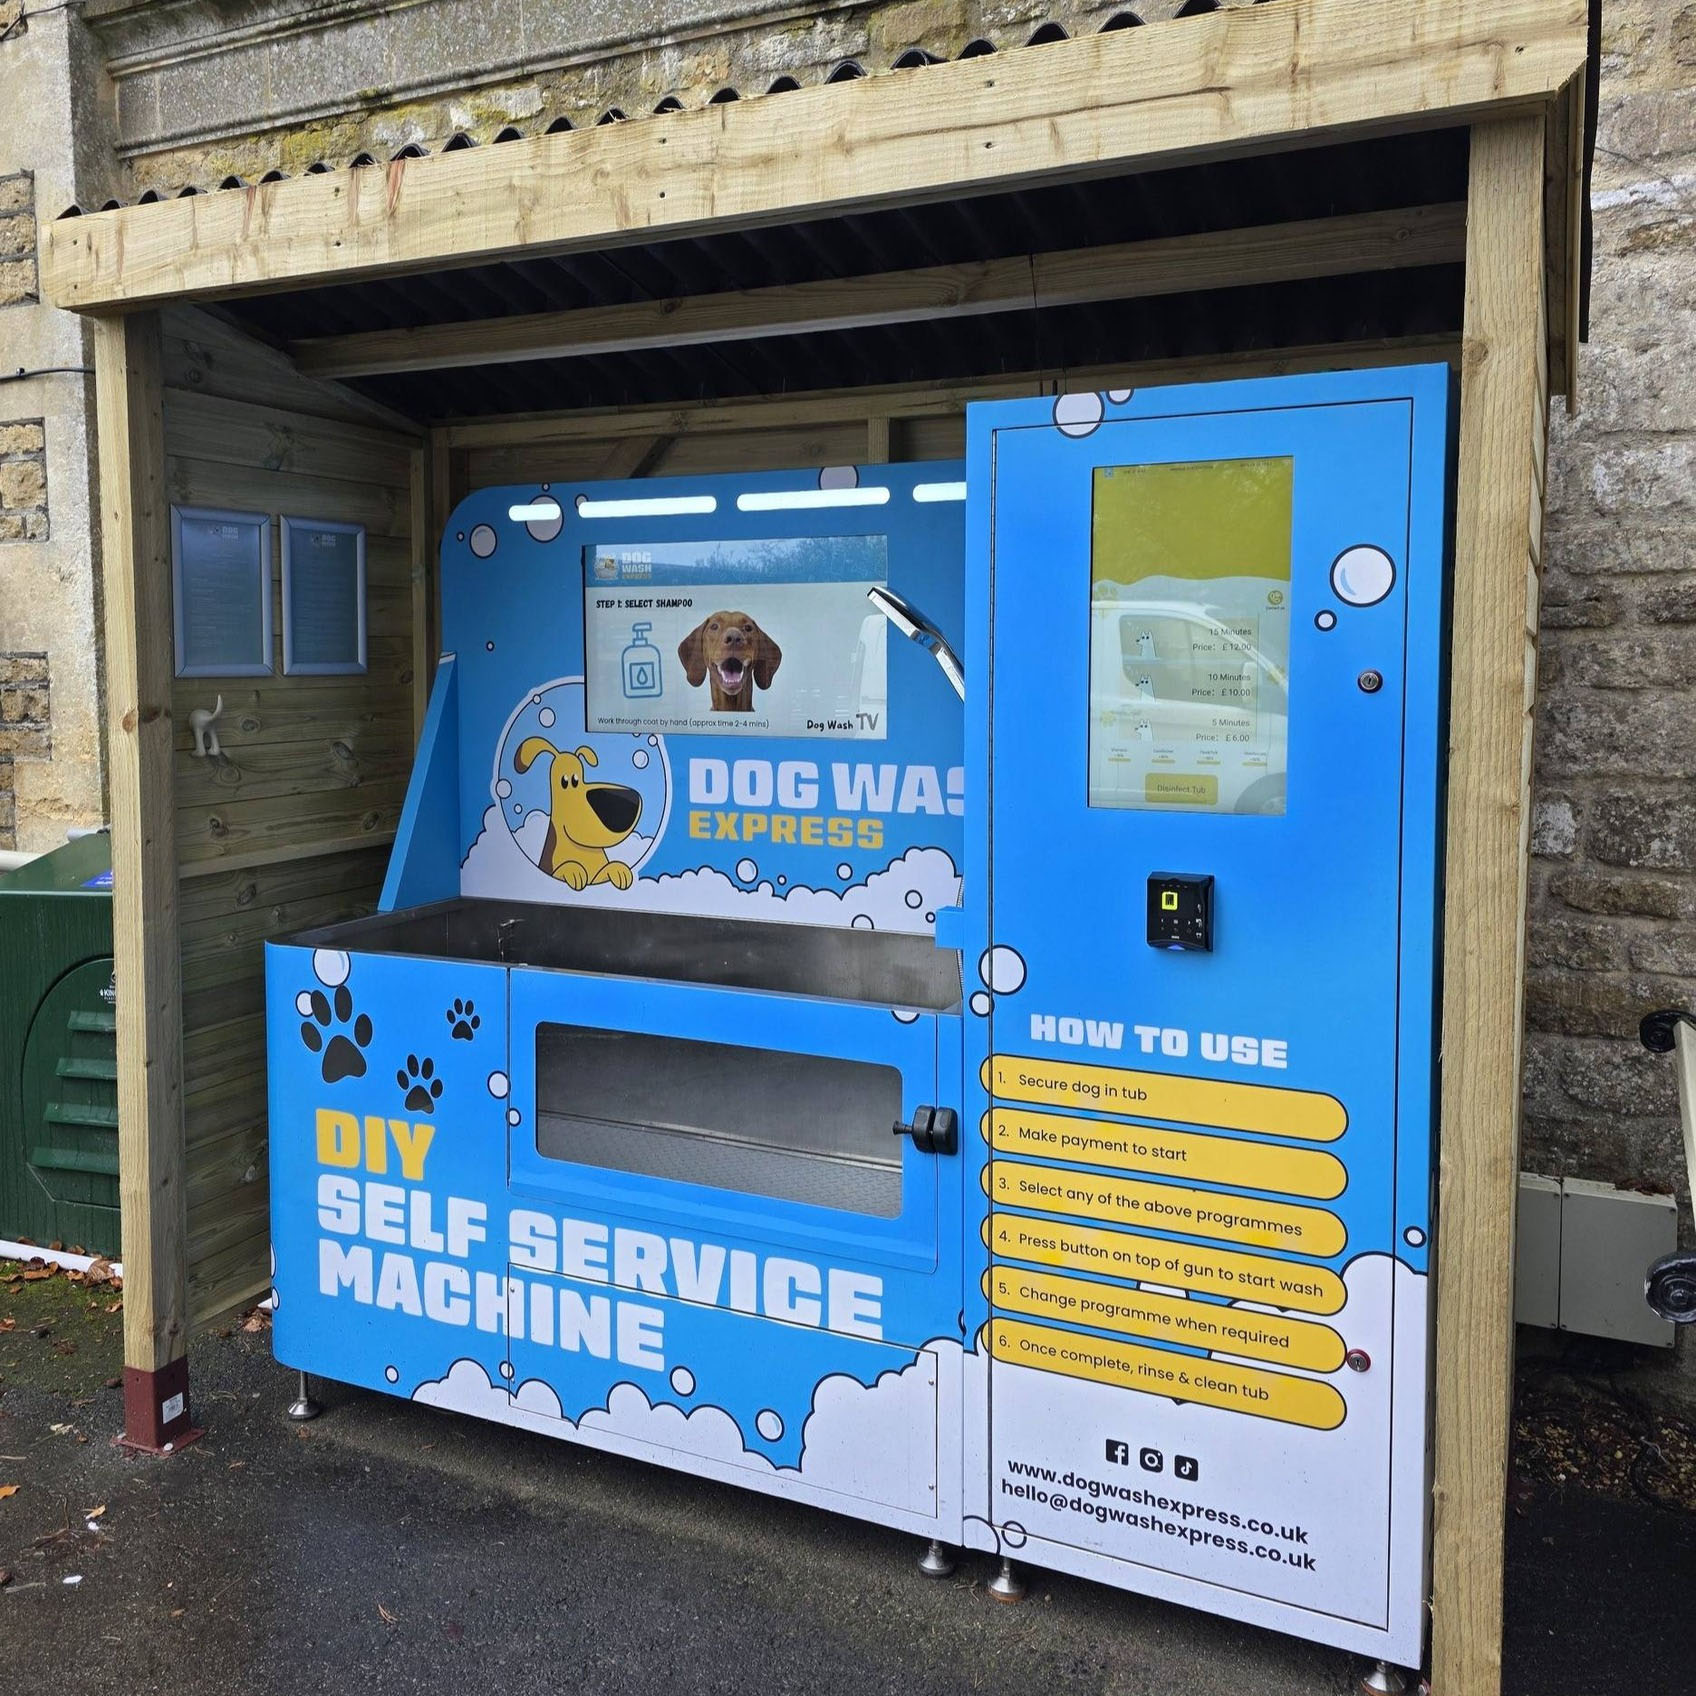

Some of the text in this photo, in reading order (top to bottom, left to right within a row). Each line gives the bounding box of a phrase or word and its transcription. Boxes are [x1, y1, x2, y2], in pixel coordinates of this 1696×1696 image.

[622, 563, 652, 573] WASH
[596, 600, 615, 608] STEP
[625, 599, 653, 608] SELECT
[656, 598, 693, 608] SHAMPOO
[1192, 643, 1216, 651] Price:
[1210, 628, 1252, 636] 15 Minutes
[1191, 688, 1216, 697] Price:
[1208, 673, 1251, 681] 10 Minutes
[597, 717, 769, 729] Work through coat by hand (approx time 2-4 mins)
[806, 712, 879, 732] Dog Wash TV
[1195, 733, 1219, 741] Price:
[1219, 719, 1250, 727] Minutes
[689, 758, 819, 809] DOG
[1157, 784, 1206, 794] Disinfect Tub
[689, 810, 884, 849] EXPRESS
[1030, 1013, 1288, 1069] HOW TO USE
[998, 1071, 1148, 1101] 1. Secure dog in tub
[316, 1107, 436, 1181] DIY
[998, 1124, 1187, 1162] 2. Make payment to start
[998, 1177, 1303, 1237] 3. Select any of the above programmes
[317, 1174, 884, 1342] SELF SERVICE
[998, 1230, 1324, 1298] 4. Press button on top of gun to start wash
[318, 1239, 665, 1372] MACHINE
[998, 1282, 1290, 1349] 5. Change programme when required
[998, 1335, 1269, 1401] 6. Once complete, rinse & clean tub
[1007, 1459, 1309, 1545] www.dogwashexpress.co.uk
[1001, 1478, 1317, 1572] hello@dogwashexpress.co.uk
